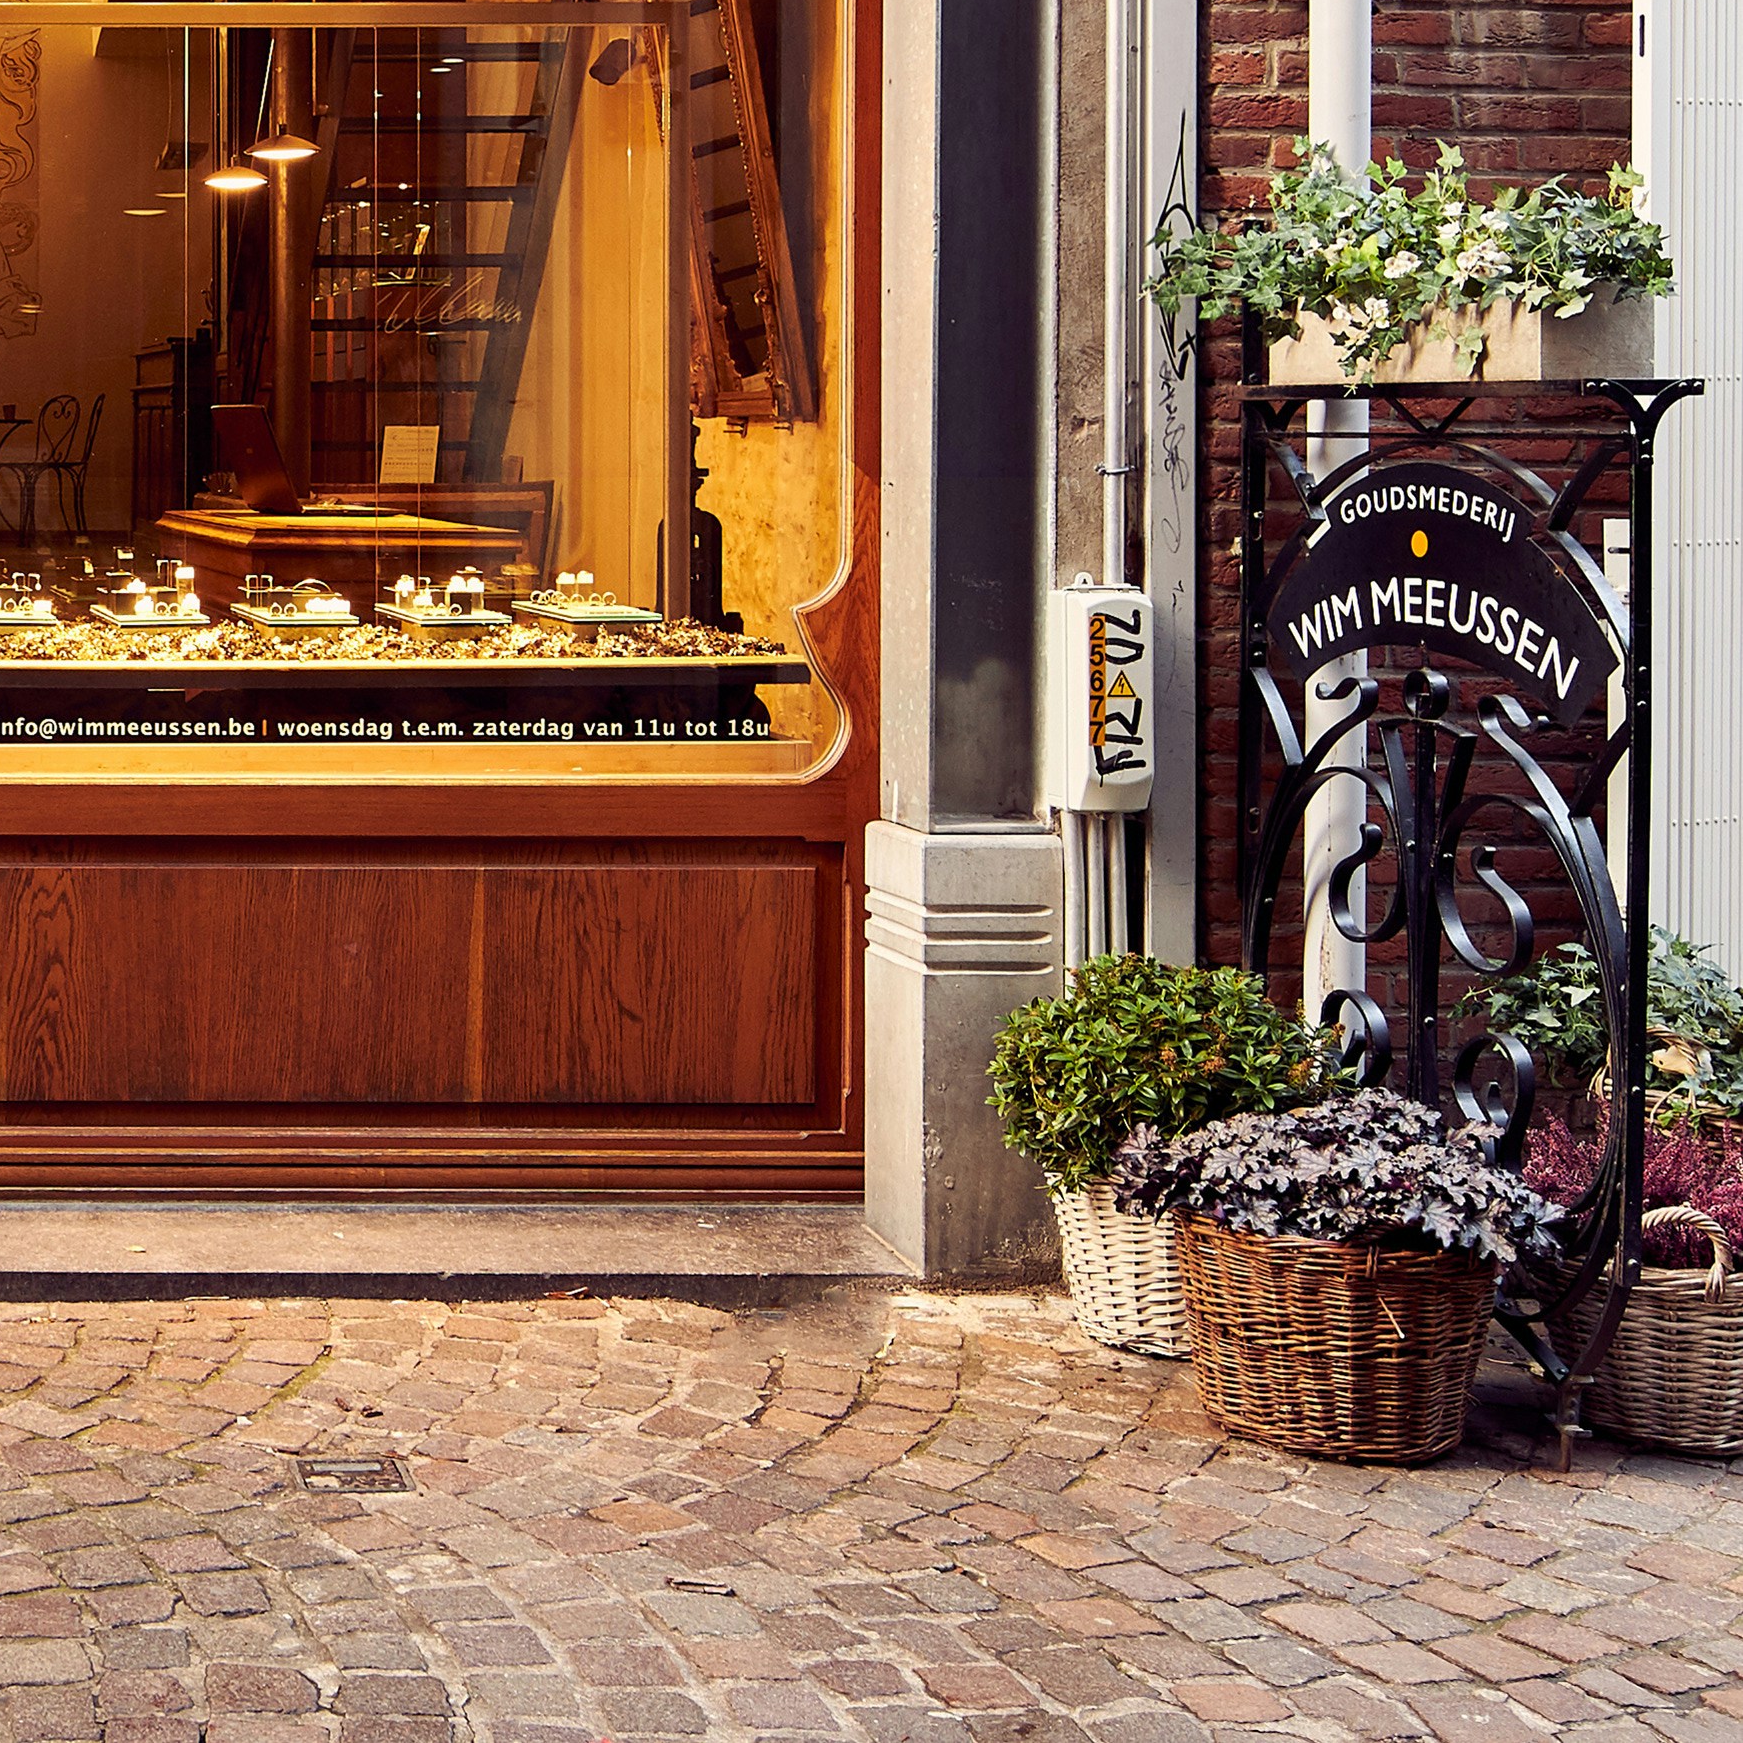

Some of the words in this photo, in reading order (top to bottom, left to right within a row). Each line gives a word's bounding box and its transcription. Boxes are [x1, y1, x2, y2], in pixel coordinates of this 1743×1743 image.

[1339, 484, 1516, 543] GOUDSMEDERIJ
[1089, 618, 1105, 745] 25677
[1287, 585, 1363, 659] WIM
[1369, 576, 1580, 701] MEEUSSEN
[276, 718, 393, 740] woensdag
[401, 720, 464, 737] t.e.m.
[472, 718, 575, 741] zaterdag
[583, 723, 624, 737] van
[633, 719, 676, 737] 11u
[684, 720, 718, 737] tot
[727, 719, 770, 737] 18u
